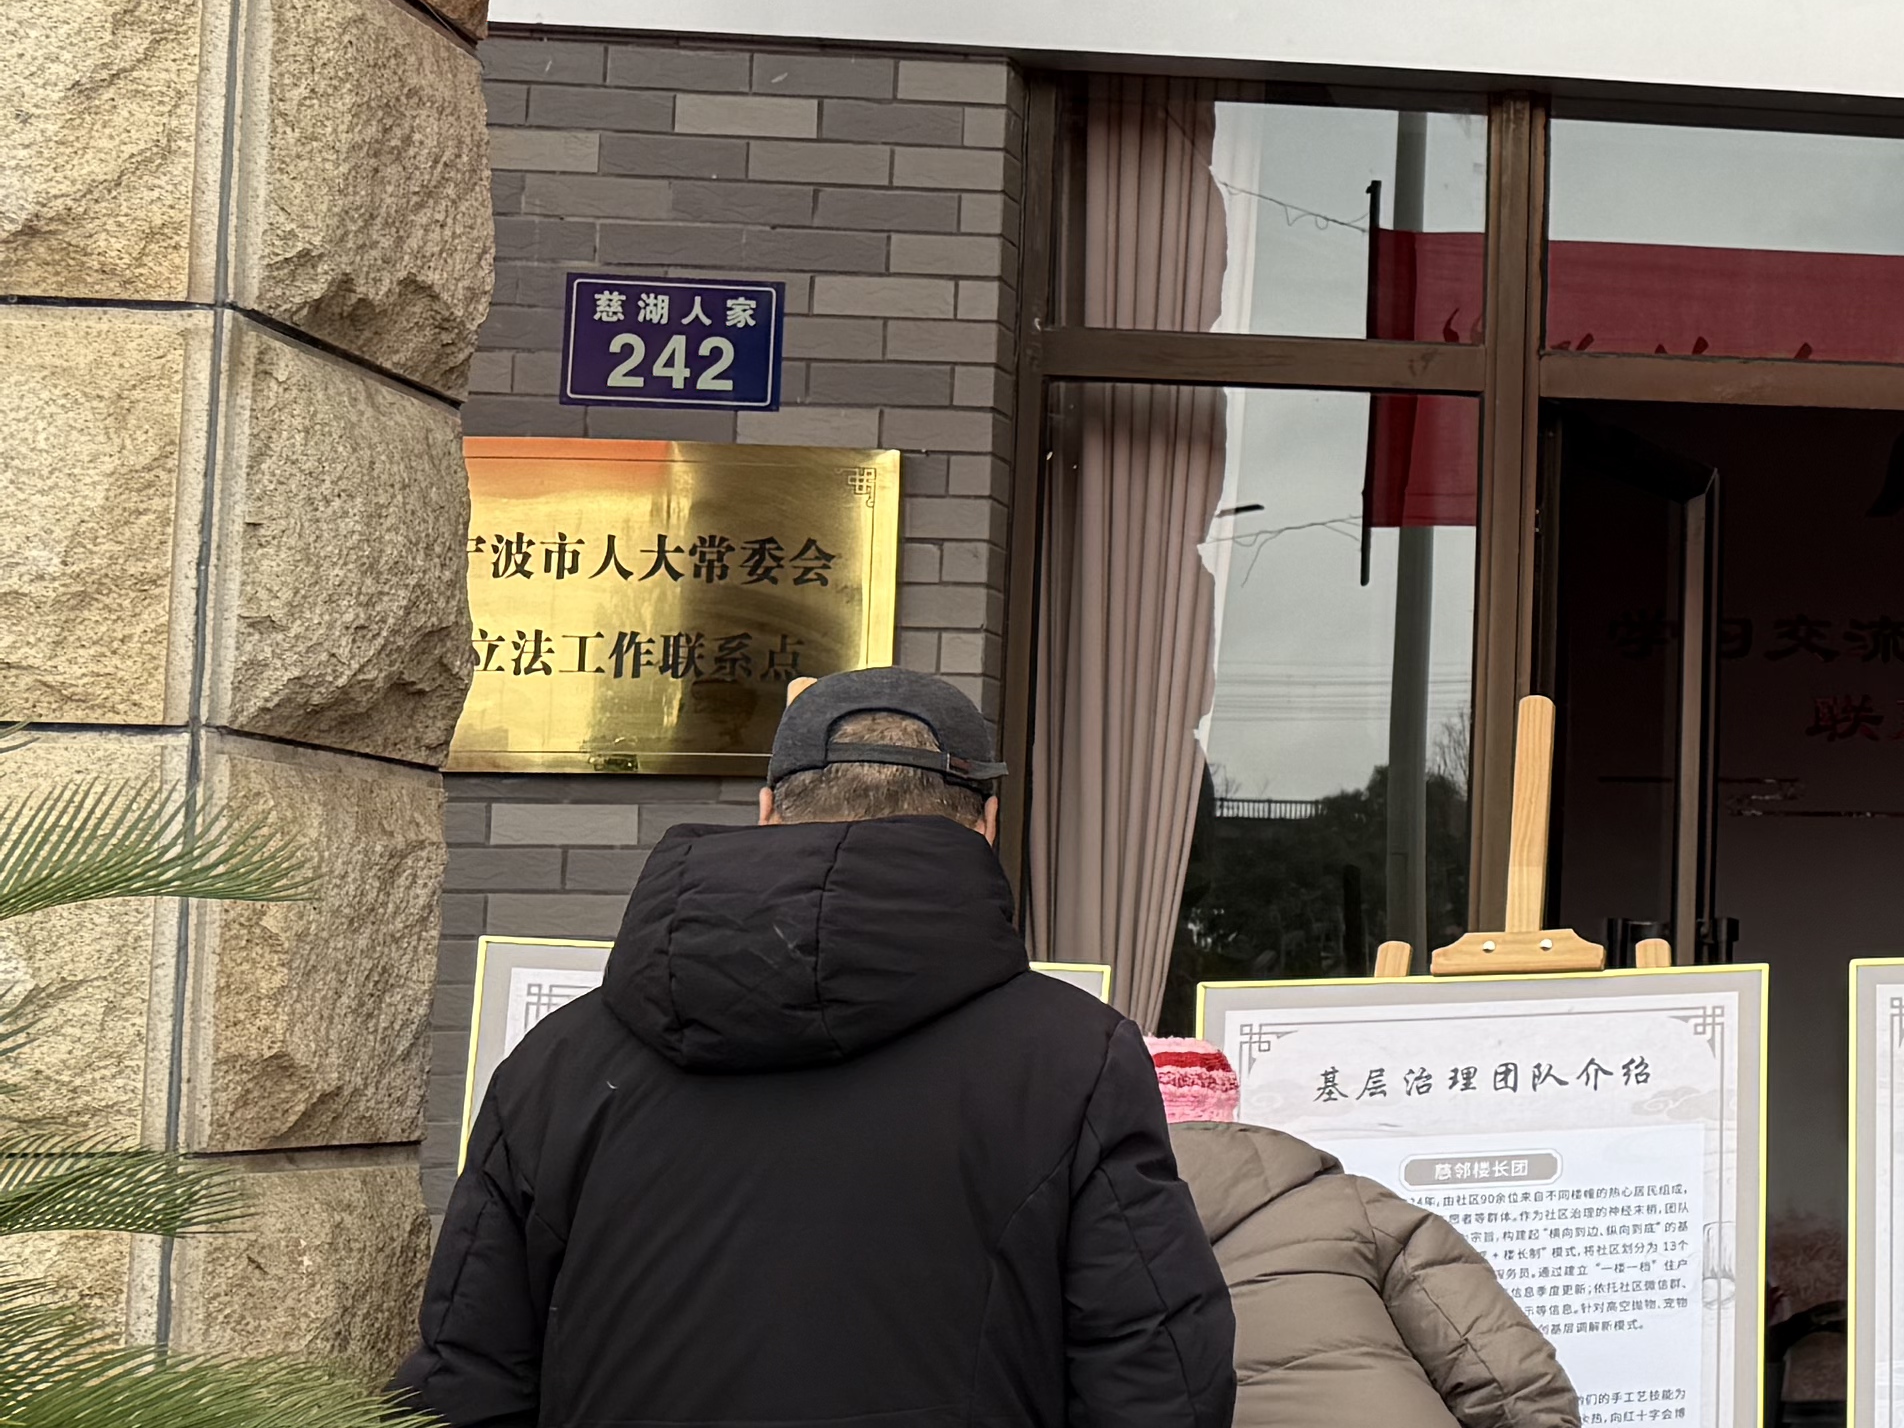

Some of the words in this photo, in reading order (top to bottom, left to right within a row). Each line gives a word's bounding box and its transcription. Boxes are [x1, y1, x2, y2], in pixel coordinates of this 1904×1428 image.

[594, 290, 757, 329] 慈湖人家
[606, 332, 736, 392] 242
[473, 628, 804, 683] 立法工作联系点
[1313, 1054, 1653, 1104] 基层治理团队介绍
